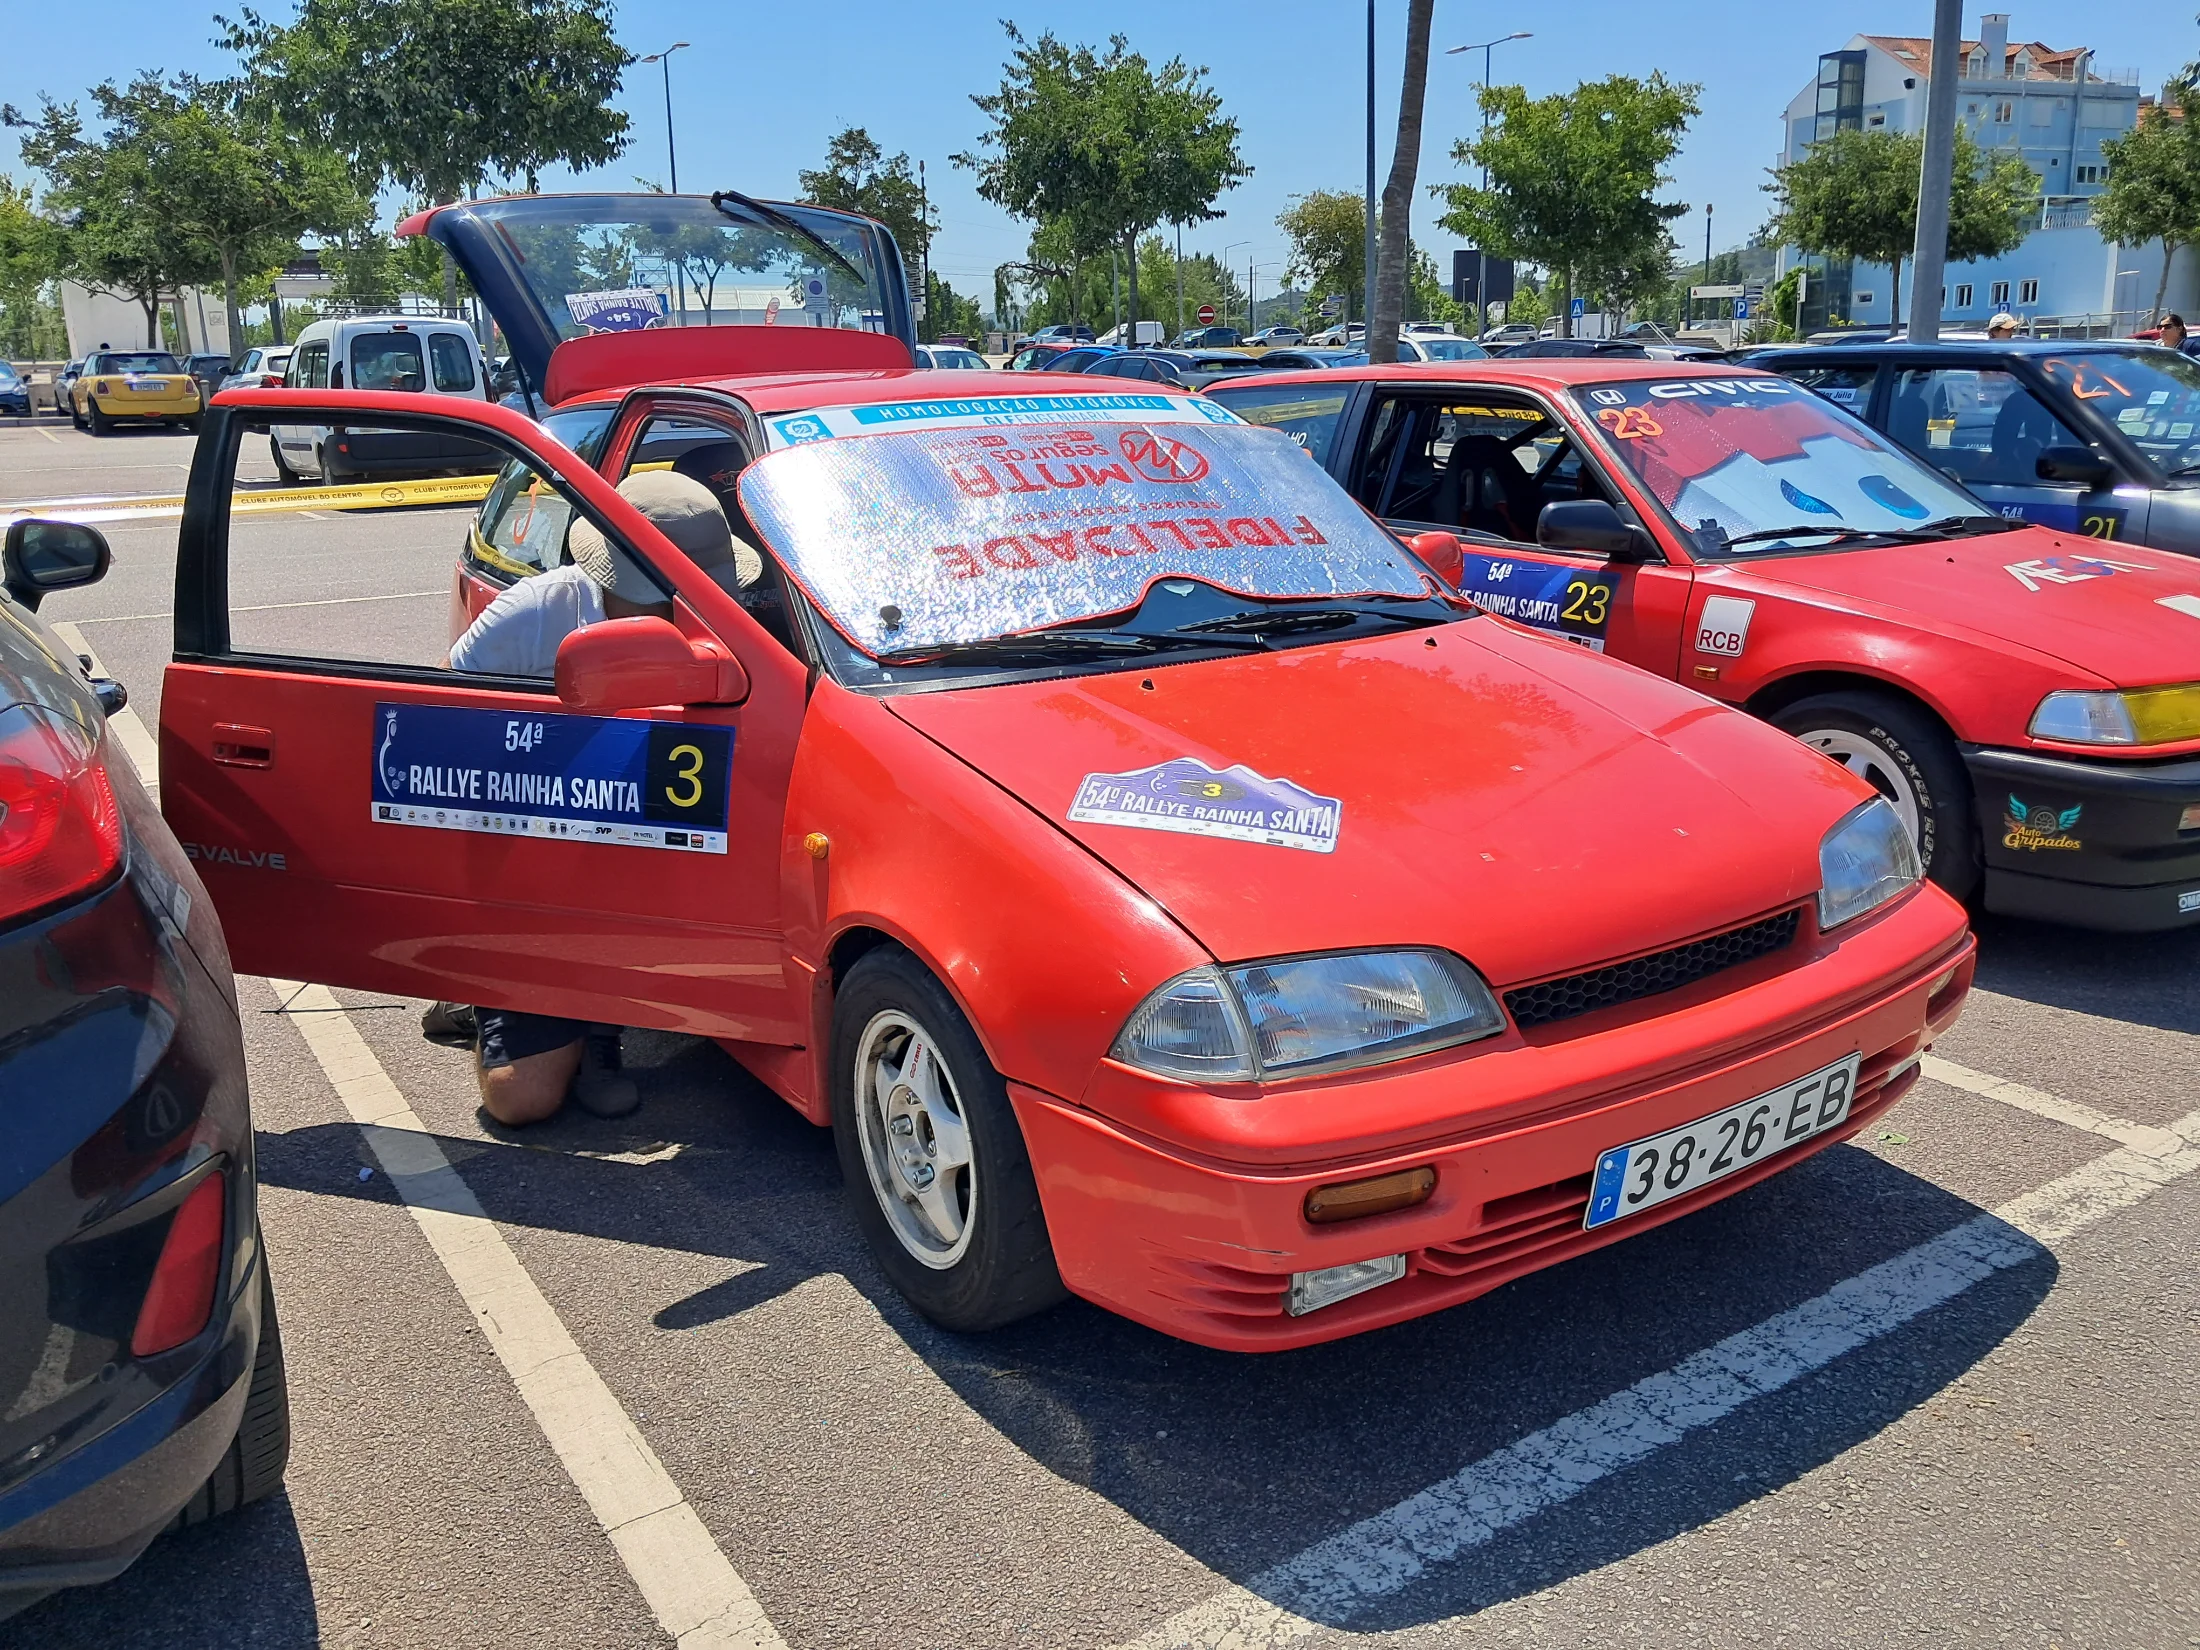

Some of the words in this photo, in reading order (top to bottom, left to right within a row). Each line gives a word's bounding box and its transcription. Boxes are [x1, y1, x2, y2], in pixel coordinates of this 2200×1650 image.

[571, 301, 598, 322] SANTA
[598, 298, 629, 312] RAINHA
[630, 296, 663, 317] RALLYE
[1736, 302, 1745, 317] P
[1648, 381, 1791, 399] CIVIC
[879, 398, 1039, 419] HOMOLOGAÇÃO
[1050, 395, 1163, 410] AUTOMÓVEL
[1598, 406, 1664, 440] 23
[990, 442, 1110, 463] seguros
[270, 495, 316, 503] AUTOMÓVEL
[332, 491, 363, 499] CENTRO
[2083, 516, 2116, 541] 21
[935, 515, 1328, 580] FIDELIDADE
[1487, 562, 1513, 583] 54ª
[1474, 591, 1516, 616] RAINHA
[1518, 598, 1558, 623] SANTA
[1560, 581, 1611, 625] 23
[1699, 629, 1741, 651] RCB
[505, 721, 543, 752] 54ª
[665, 745, 704, 807] 3
[409, 764, 482, 800] RALLYE
[487, 772, 565, 806] RAINHA
[570, 778, 640, 812] SANTA
[1201, 783, 1223, 798] 3
[1120, 792, 1190, 818] RALLYE
[1193, 806, 1264, 828] RAINHA
[1268, 806, 1334, 838] SANTA
[595, 826, 612, 836] SVP
[2003, 833, 2081, 850] Gripados
[2018, 826, 2042, 837] Auto
[1599, 1196, 1612, 1212] P
